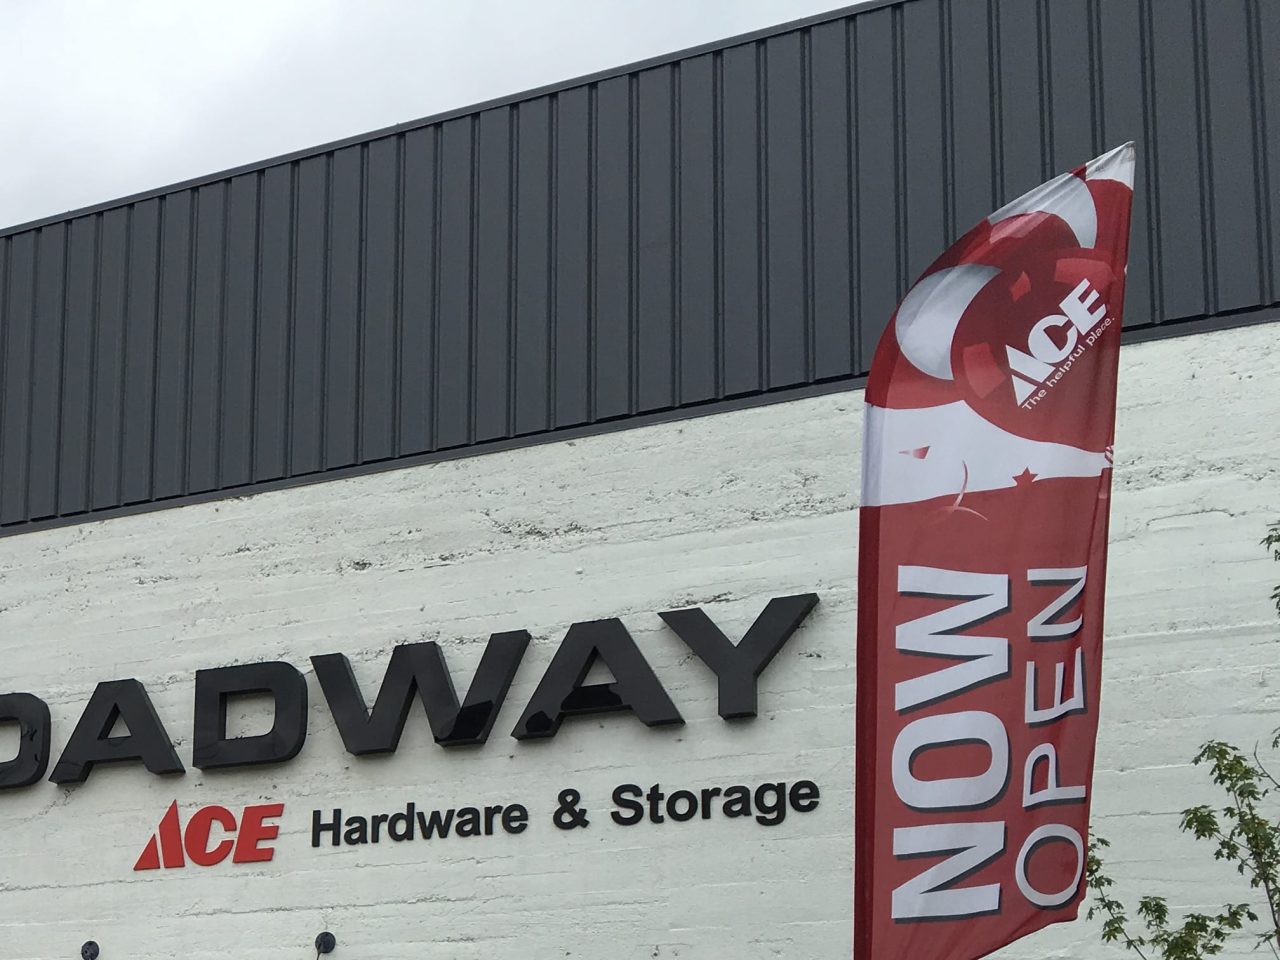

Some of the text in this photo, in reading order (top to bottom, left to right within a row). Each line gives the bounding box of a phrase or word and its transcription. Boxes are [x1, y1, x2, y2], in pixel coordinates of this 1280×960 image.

[1005, 278, 1108, 407] ACE
[1021, 316, 1116, 411] The helpful place.
[891, 564, 1012, 922] NOW
[1015, 564, 1088, 909] OPEN
[133, 778, 821, 871] ACE Hardware & Storage
